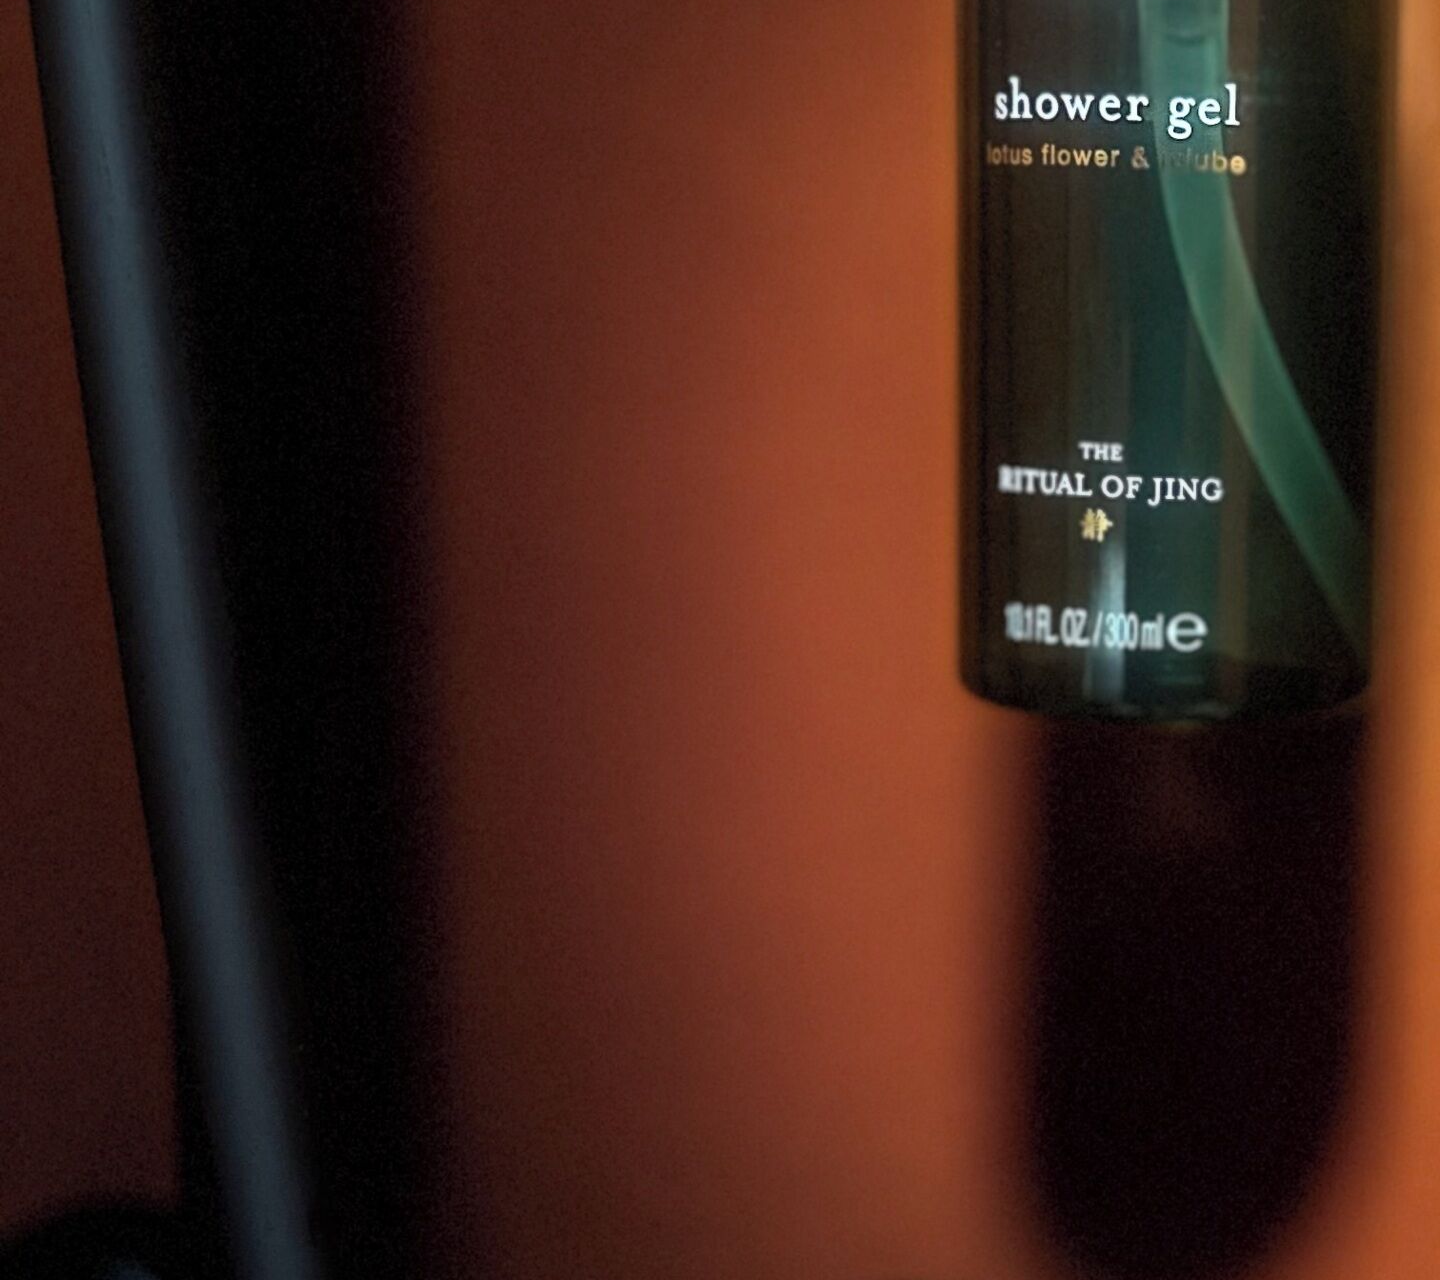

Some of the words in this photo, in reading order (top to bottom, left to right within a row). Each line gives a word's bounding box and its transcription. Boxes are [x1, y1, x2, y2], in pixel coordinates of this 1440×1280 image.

[994, 75, 1150, 122] shower
[1166, 83, 1241, 140] gel
[985, 141, 1034, 167] lotus
[1040, 142, 1121, 169] flower
[1130, 145, 1151, 170] &
[1158, 146, 1247, 176] ube
[1077, 440, 1124, 463] THE
[998, 464, 1093, 497] RITUAL
[1101, 474, 1143, 500] OF
[1147, 477, 1224, 507] JING
